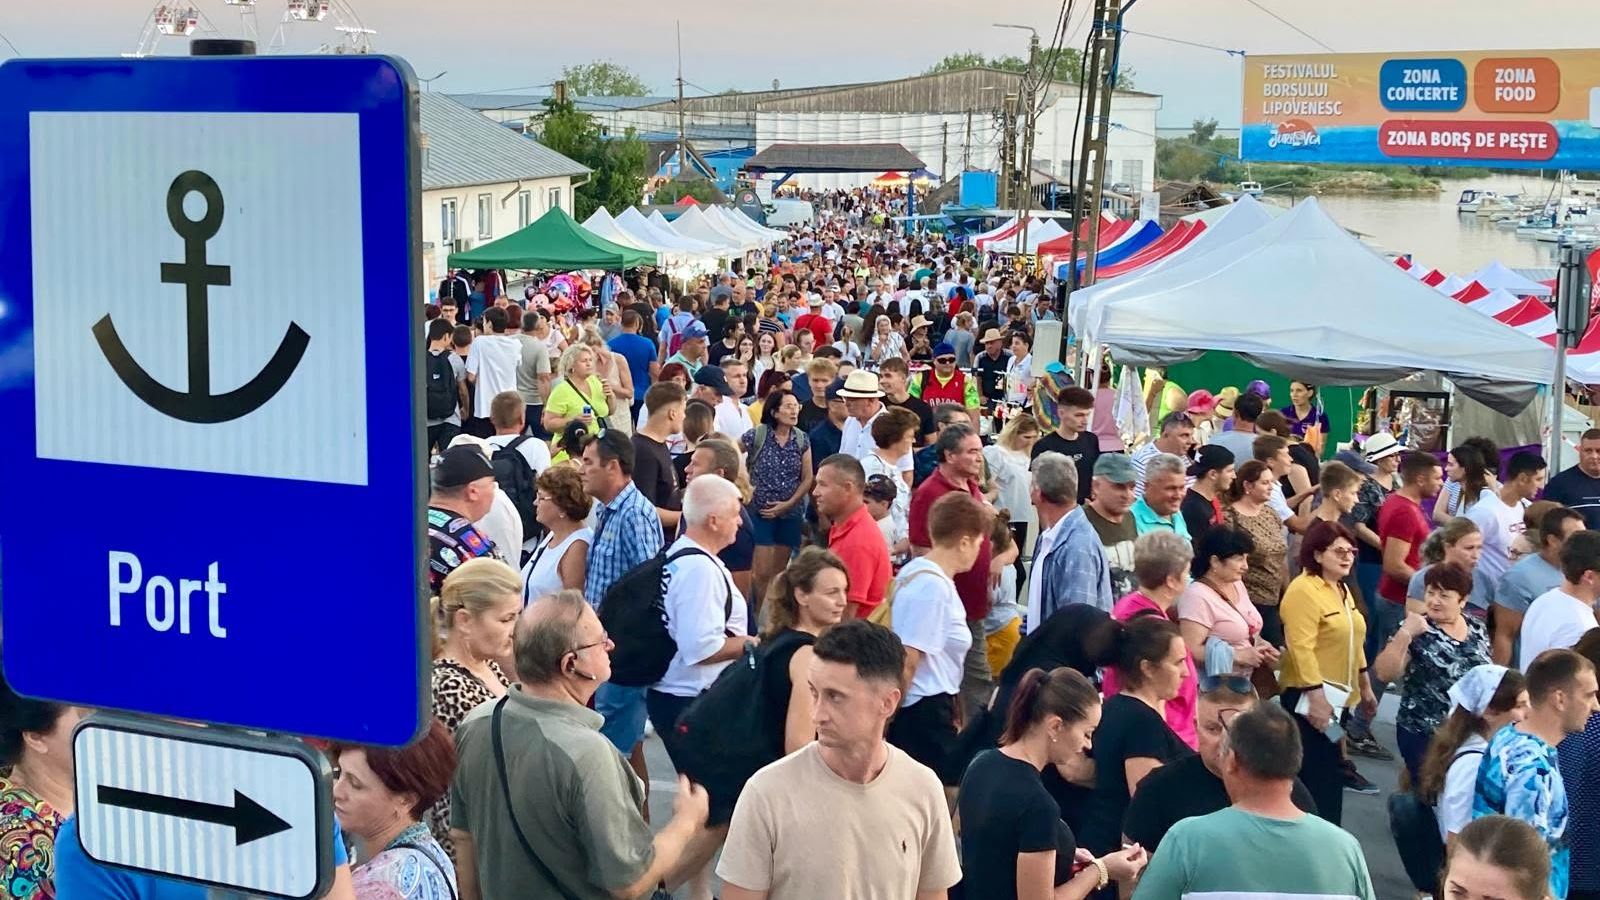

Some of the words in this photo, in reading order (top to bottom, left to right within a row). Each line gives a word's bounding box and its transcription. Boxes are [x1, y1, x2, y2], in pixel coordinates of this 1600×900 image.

[1263, 64, 1339, 79] FESTIVALUL
[1402, 69, 1441, 84] ZONA
[1494, 68, 1536, 83] ZONA
[1386, 86, 1459, 101] CONCERTE
[1495, 86, 1536, 101] FOOD
[1263, 101, 1343, 115] LIPOVENESC
[1387, 131, 1427, 146] ZONA
[1475, 132, 1495, 147] DE
[108, 550, 227, 639] Port
